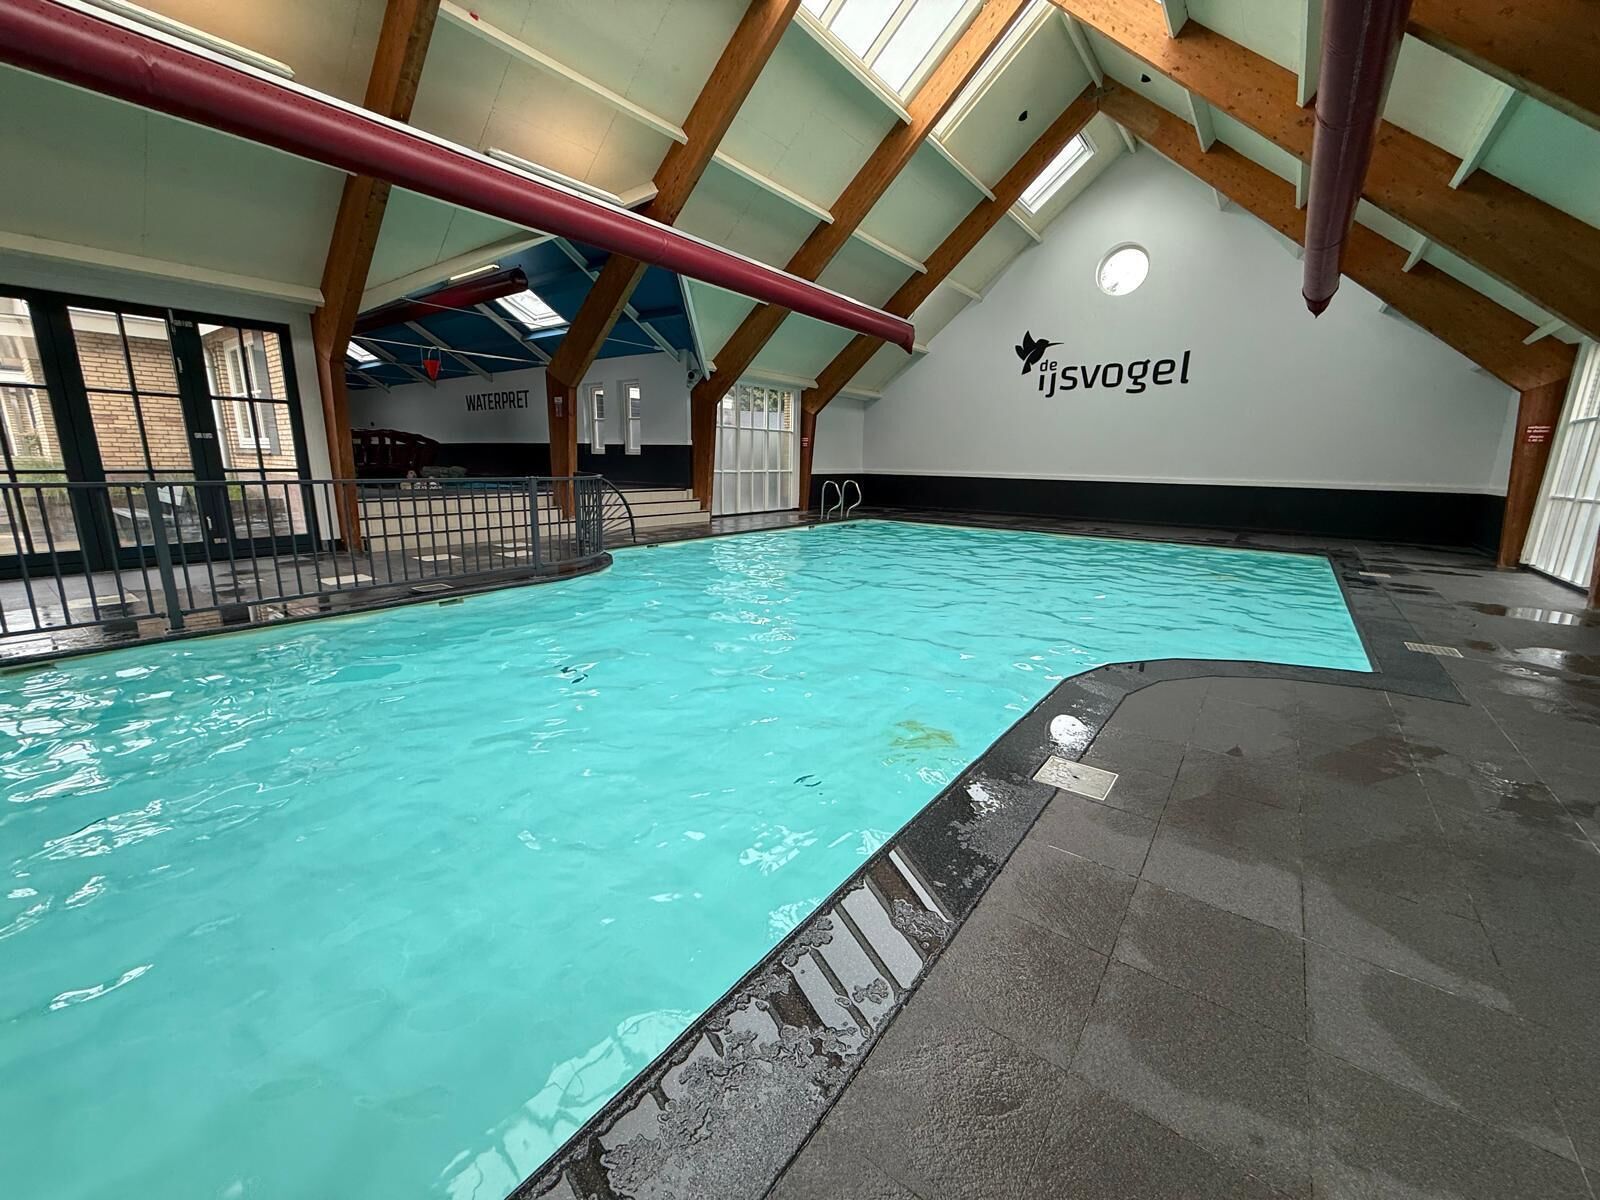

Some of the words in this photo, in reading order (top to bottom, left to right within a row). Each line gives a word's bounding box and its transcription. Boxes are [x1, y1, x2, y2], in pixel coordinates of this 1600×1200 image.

[1038, 350, 1191, 398] ijsvogel
[1040, 359, 1058, 372] de
[465, 389, 529, 411] WATERPRET
